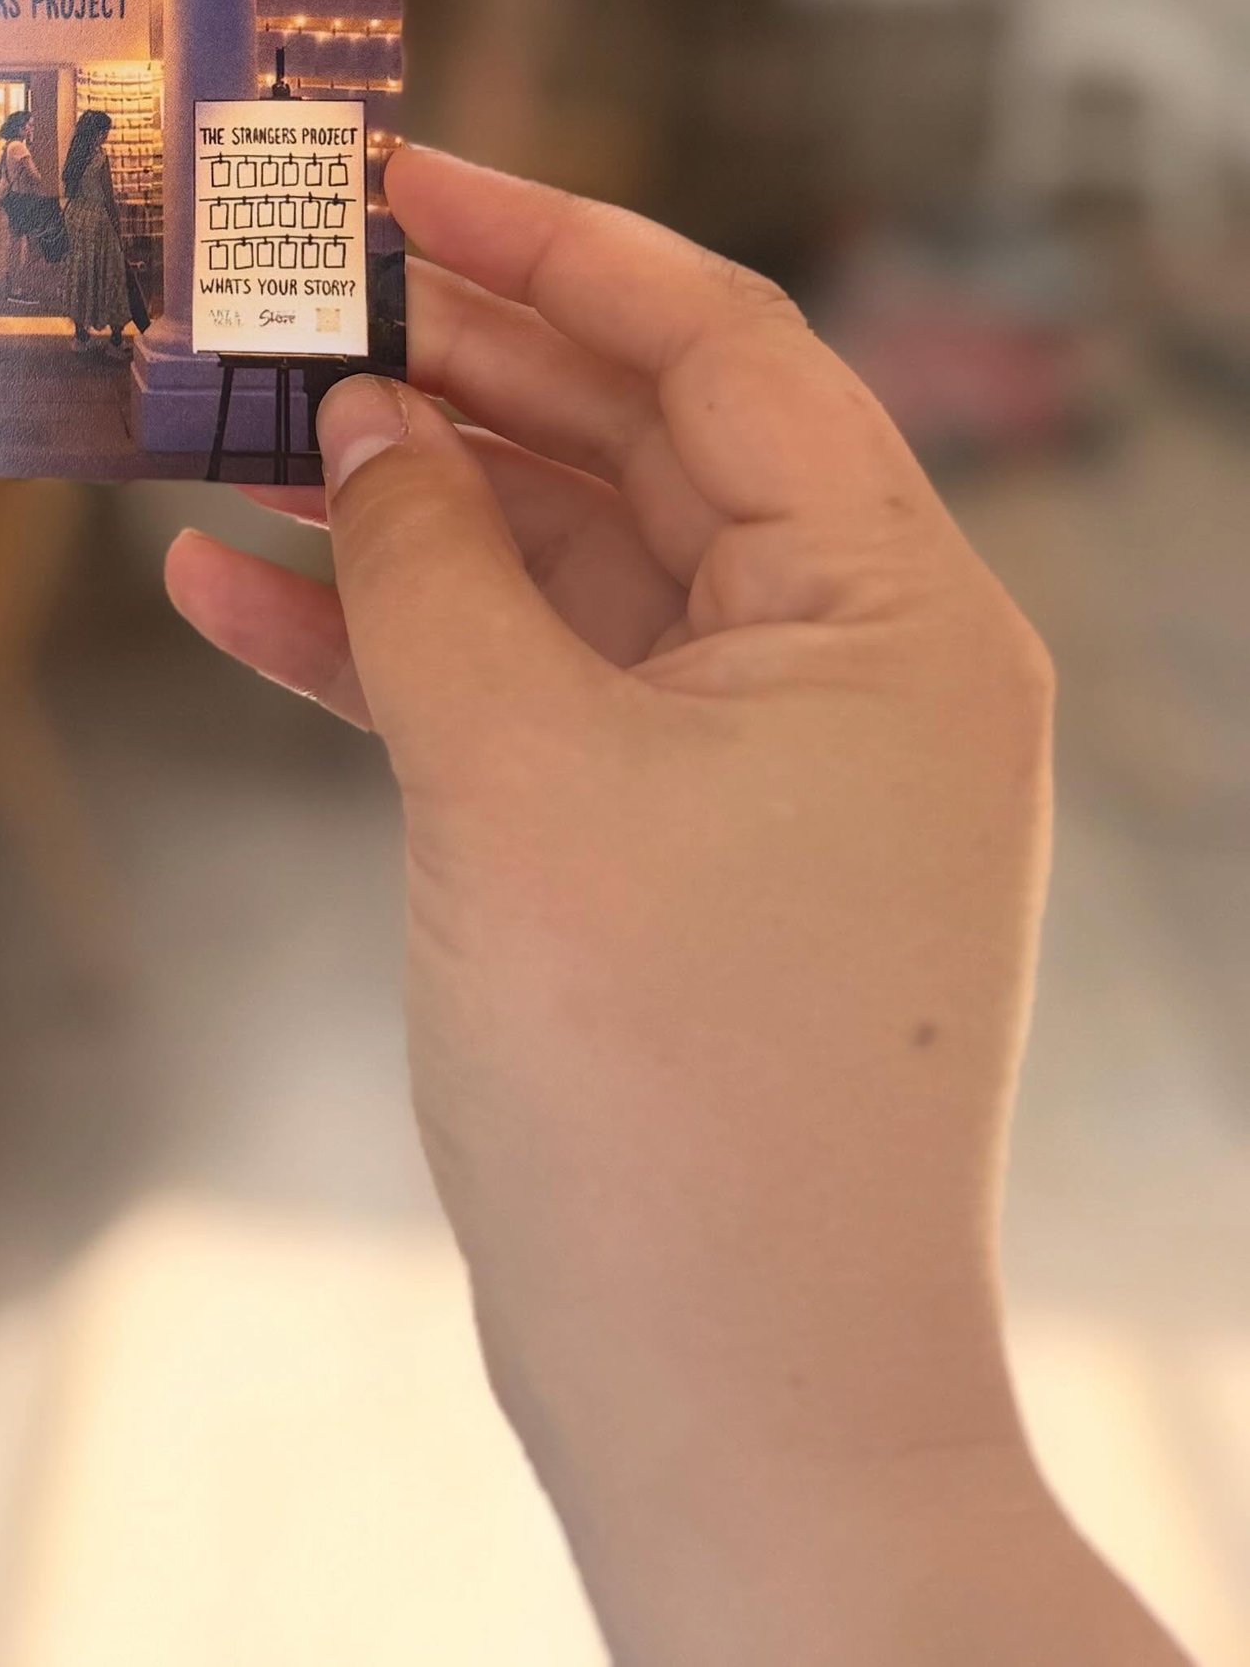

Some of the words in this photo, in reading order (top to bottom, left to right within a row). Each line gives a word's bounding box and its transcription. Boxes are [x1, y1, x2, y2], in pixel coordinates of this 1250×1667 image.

[200, 127, 225, 145] THE
[232, 127, 297, 145] STRANGERS
[302, 127, 358, 145] PROJECT
[257, 278, 298, 295] YOUR
[304, 279, 356, 297] STORY?
